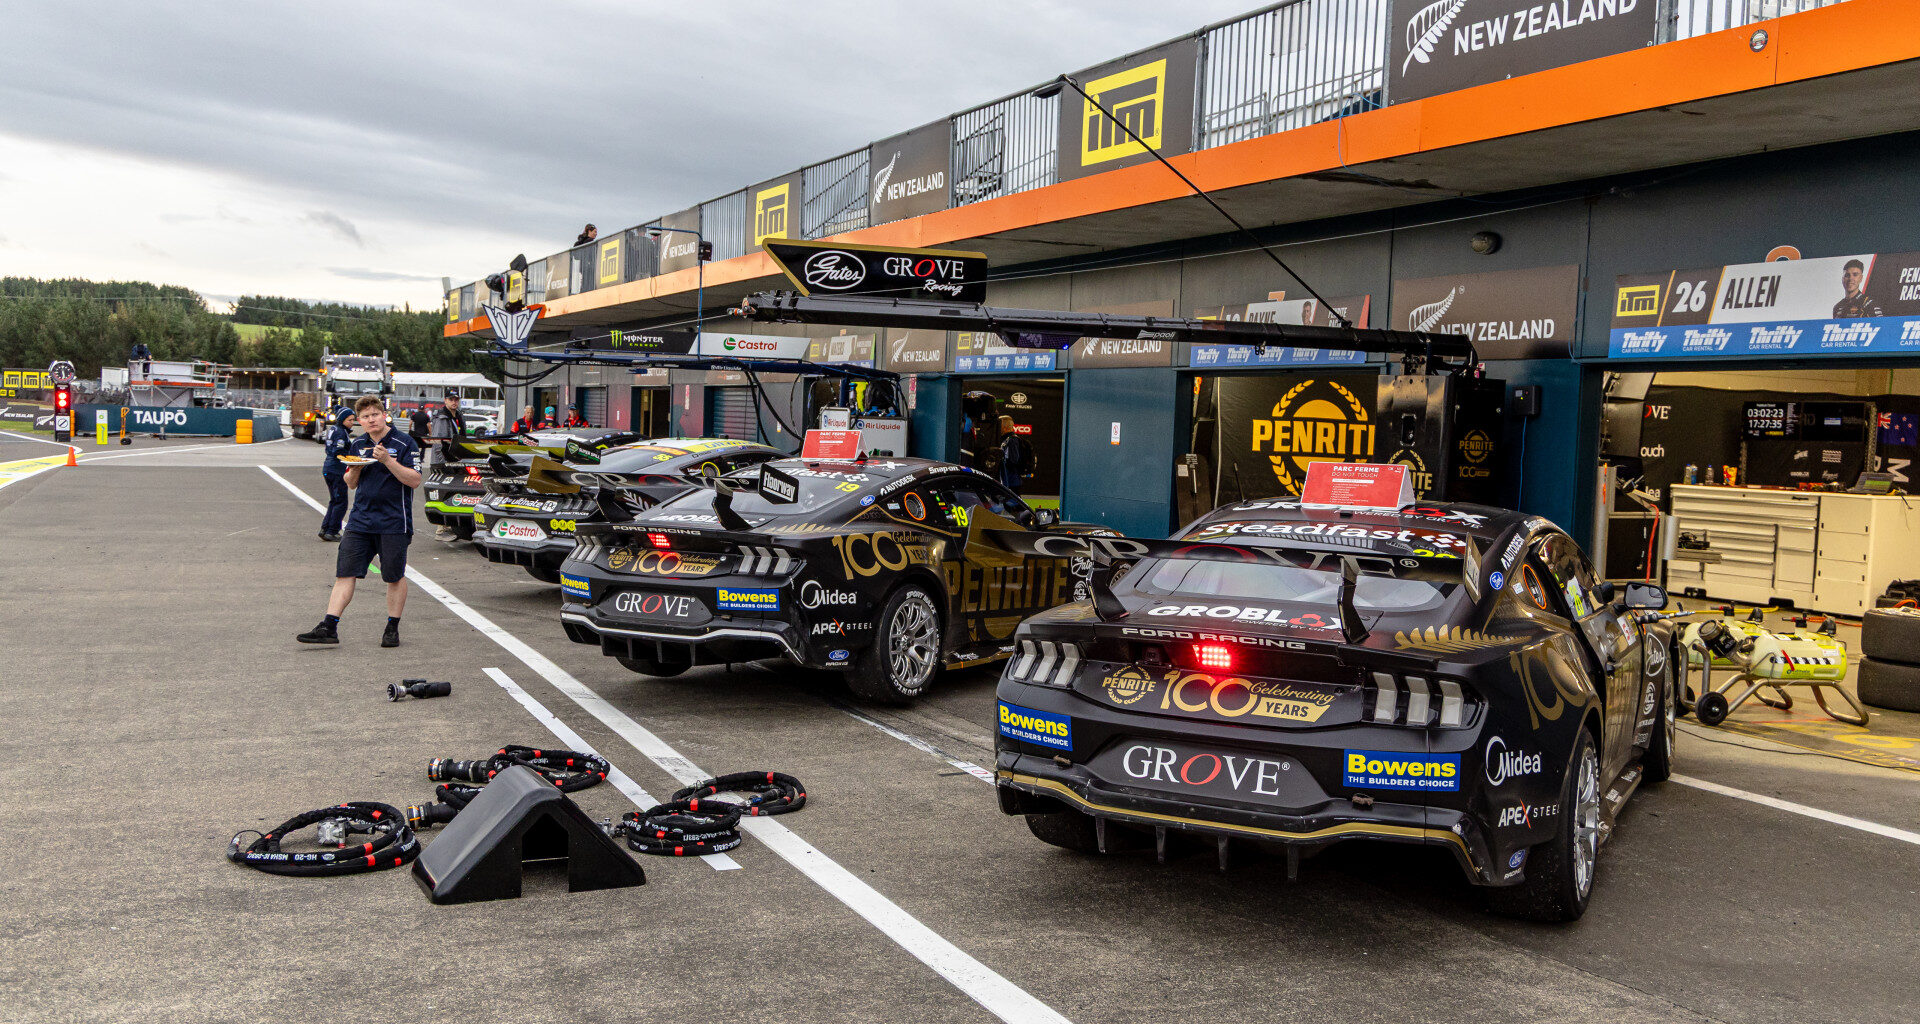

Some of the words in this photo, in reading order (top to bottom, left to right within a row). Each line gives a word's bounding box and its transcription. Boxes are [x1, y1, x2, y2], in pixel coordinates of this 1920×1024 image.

[1454, 14, 1510, 56] NEW
[1512, 0, 1638, 42] ZEALAND
[887, 184, 905, 200] NEW
[906, 171, 944, 197] ZEALAND
[669, 247, 678, 258] NEW
[677, 241, 696, 257] ZEALAND
[808, 254, 864, 287] Gates
[883, 256, 965, 281] GROVE
[923, 279, 964, 296] Racing
[1672, 281, 1707, 313] 26
[1721, 275, 1782, 310] ALLEN
[1153, 331, 1176, 341] paoli
[1440, 322, 1476, 342] NEW
[1478, 318, 1555, 342] ZEALAND
[1683, 328, 1733, 351] Thrifty
[1749, 325, 1803, 349] Thrifty
[1821, 323, 1881, 347] Thrifty
[738, 340, 777, 351] Castrol
[973, 332, 984, 349] 55
[1100, 340, 1120, 355] NEW
[1121, 338, 1162, 355] ZEALAND
[1622, 331, 1668, 353] Thrifty
[902, 350, 915, 363] NEW
[915, 348, 940, 362] ZEALAND
[1196, 347, 1220, 363] Thrifty
[1227, 346, 1251, 363] Thrifty
[133, 409, 187, 426] TAUPŌ
[1747, 408, 1784, 418] 03:02:23
[1012, 425, 1031, 433] YCO
[1748, 419, 1782, 429] 17:27:35
[1459, 440, 1494, 451] PENRITE
[928, 465, 960, 475] Snap-on
[763, 470, 796, 498] Floorway
[834, 481, 860, 493] 19
[886, 473, 917, 493] AUTODESK
[951, 506, 969, 527] 19
[508, 524, 539, 538] Castrol
[612, 524, 648, 533] FORD
[648, 526, 702, 536] RACING
[630, 549, 683, 575] 100
[831, 530, 908, 581] 100
[682, 565, 705, 573] YEARS
[560, 574, 590, 591] Bowens
[941, 557, 1068, 613] PENRITE
[615, 592, 692, 617] GROVE
[718, 589, 777, 603] Bowens
[808, 588, 857, 607] Midea
[812, 619, 846, 637] APEX
[846, 622, 873, 631] STEEL
[1122, 627, 1196, 640] FORD
[1199, 632, 1306, 650] RACING
[1102, 675, 1157, 694] PENRITE
[1160, 669, 1257, 718] 100
[1249, 680, 1336, 705] Celebrating
[1265, 702, 1309, 718] YEARS
[999, 704, 1069, 738] Bowens
[1001, 725, 1011, 734] THE
[1011, 728, 1042, 743] BUILDERS
[1042, 735, 1069, 747] CHOICE
[1122, 744, 1281, 796] GROVE
[1347, 753, 1457, 778] Bowens
[1495, 748, 1542, 786] Midea
[1348, 775, 1366, 784] THE
[1368, 777, 1416, 786] BUILDERS
[1418, 779, 1455, 788] CHOICE
[1498, 800, 1532, 829] APEX
[1533, 803, 1560, 819] STEEL
